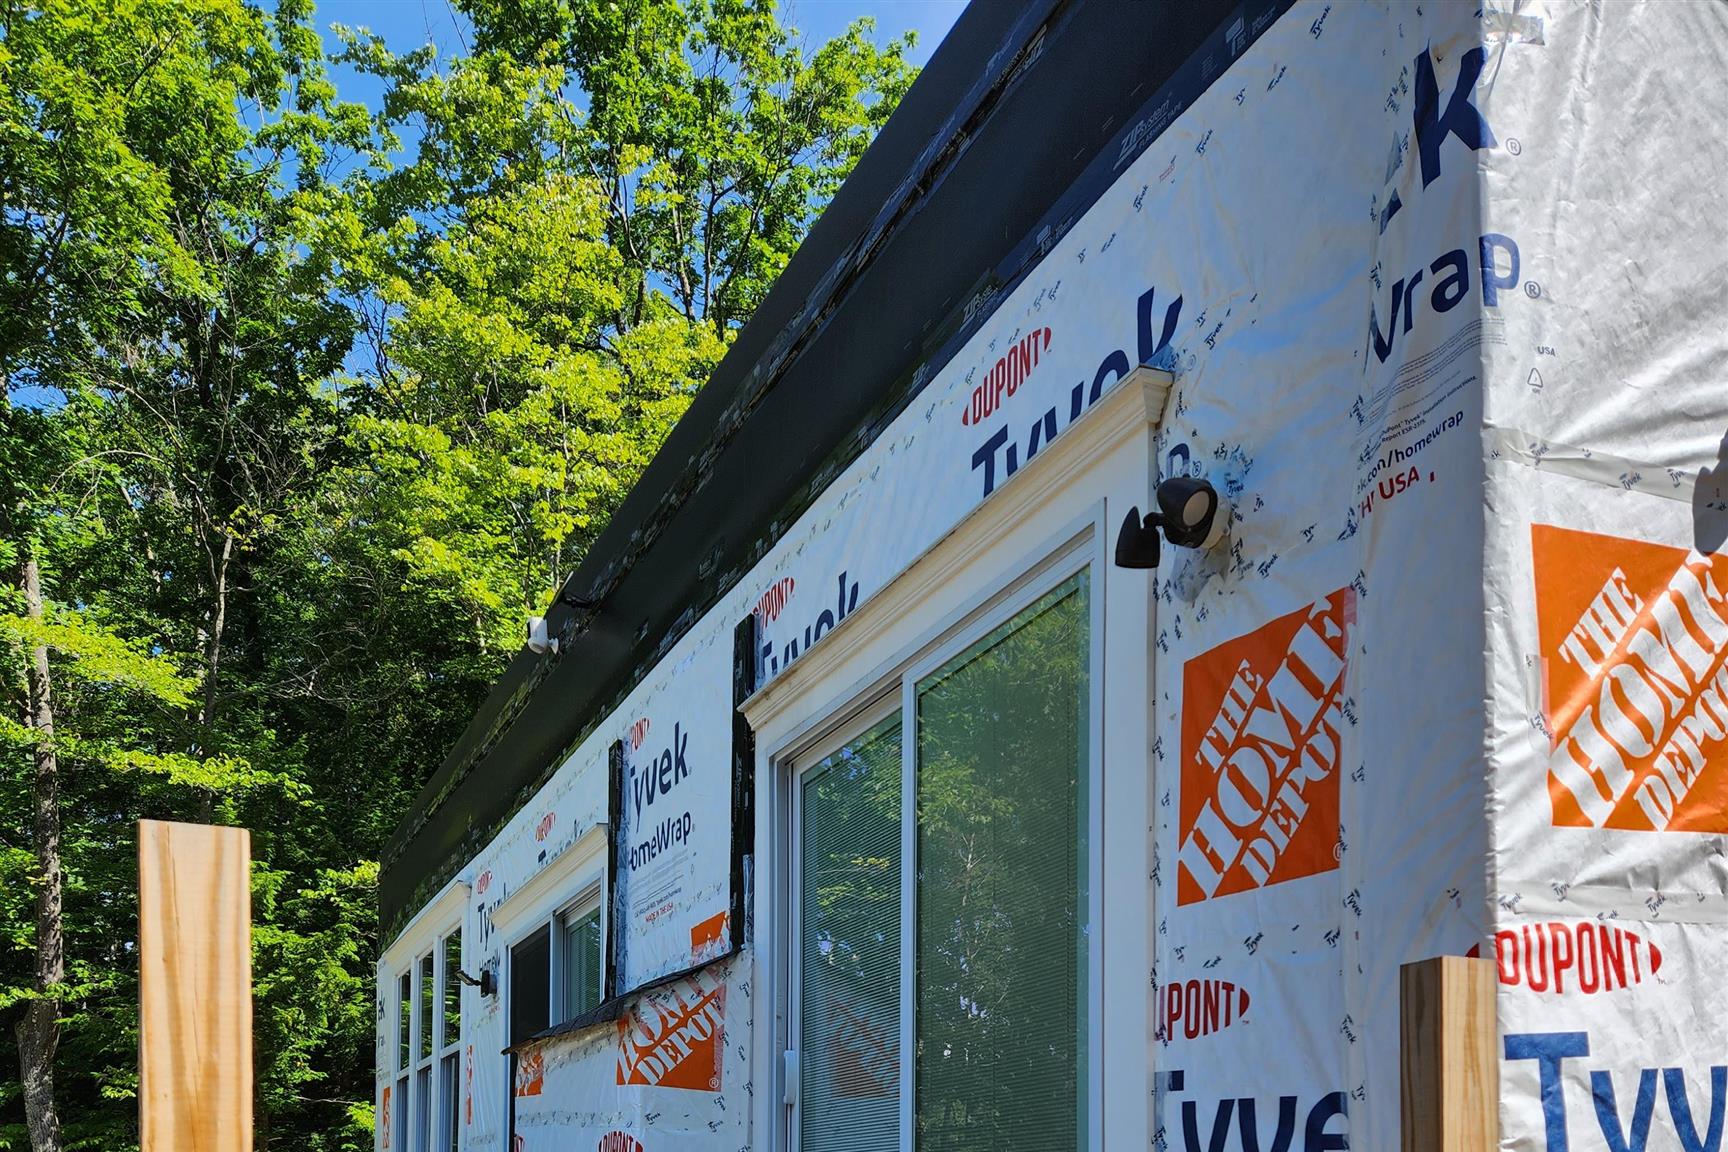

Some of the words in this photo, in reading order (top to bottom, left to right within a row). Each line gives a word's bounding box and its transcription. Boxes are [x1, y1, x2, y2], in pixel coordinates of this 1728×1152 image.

[1310, 5, 1332, 38] Tyvek
[1196, 129, 1214, 154] Tyvek
[1133, 184, 1149, 211] Tyvek
[1204, 320, 1225, 350] Tyvek
[1537, 345, 1556, 357] USA
[971, 327, 1042, 426] DUPONT
[1378, 465, 1420, 500] USA
[1622, 472, 1643, 491] Tyvek
[1258, 553, 1279, 579] Tyvek
[1354, 572, 1368, 599] Tyvek
[1557, 565, 1645, 681] THE
[1194, 658, 1266, 775] THE
[1343, 700, 1359, 728] Tyvek
[1533, 713, 1554, 741] Tyvek
[1347, 891, 1363, 918] Tyvek
[1501, 892, 1523, 912] Tyvek
[1647, 894, 1667, 914] Tyvek
[1494, 921, 1642, 995] DUPONT
[1342, 1016, 1358, 1045] Tyvek
